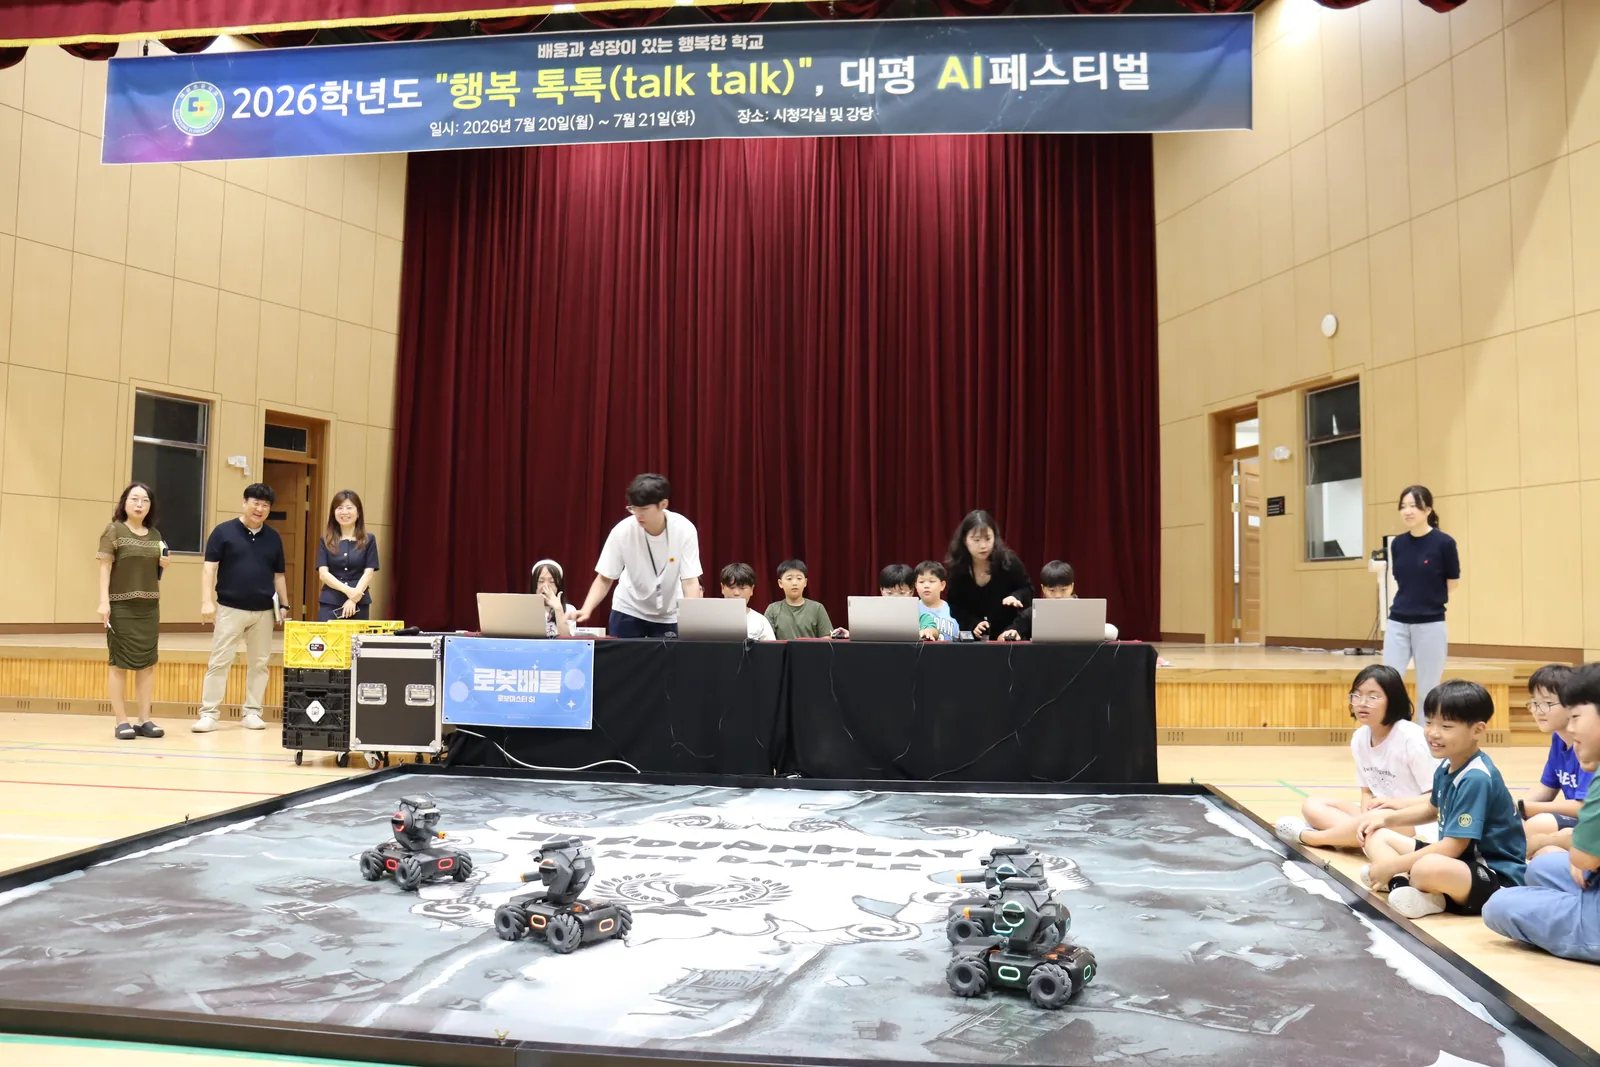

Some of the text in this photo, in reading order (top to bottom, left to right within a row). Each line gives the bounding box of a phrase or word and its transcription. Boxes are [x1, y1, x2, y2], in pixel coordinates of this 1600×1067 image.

[537, 34, 765, 60] 배움과 성장이 있는 행복한 학교
[231, 77, 423, 119] 2026학년도
[436, 71, 521, 110] "행복
[532, 64, 696, 106] 톡톡(talk
[840, 56, 915, 95] 대평
[429, 121, 459, 137] 일시:
[462, 118, 511, 135] 2026년
[514, 116, 536, 133] 7월
[538, 113, 594, 132] 20일(월)
[613, 112, 636, 128] 7월
[638, 109, 696, 127] 21일(화)
[737, 106, 874, 124] 장소: 시청각실 및 강당
[473, 668, 562, 694] 로봇배틀
